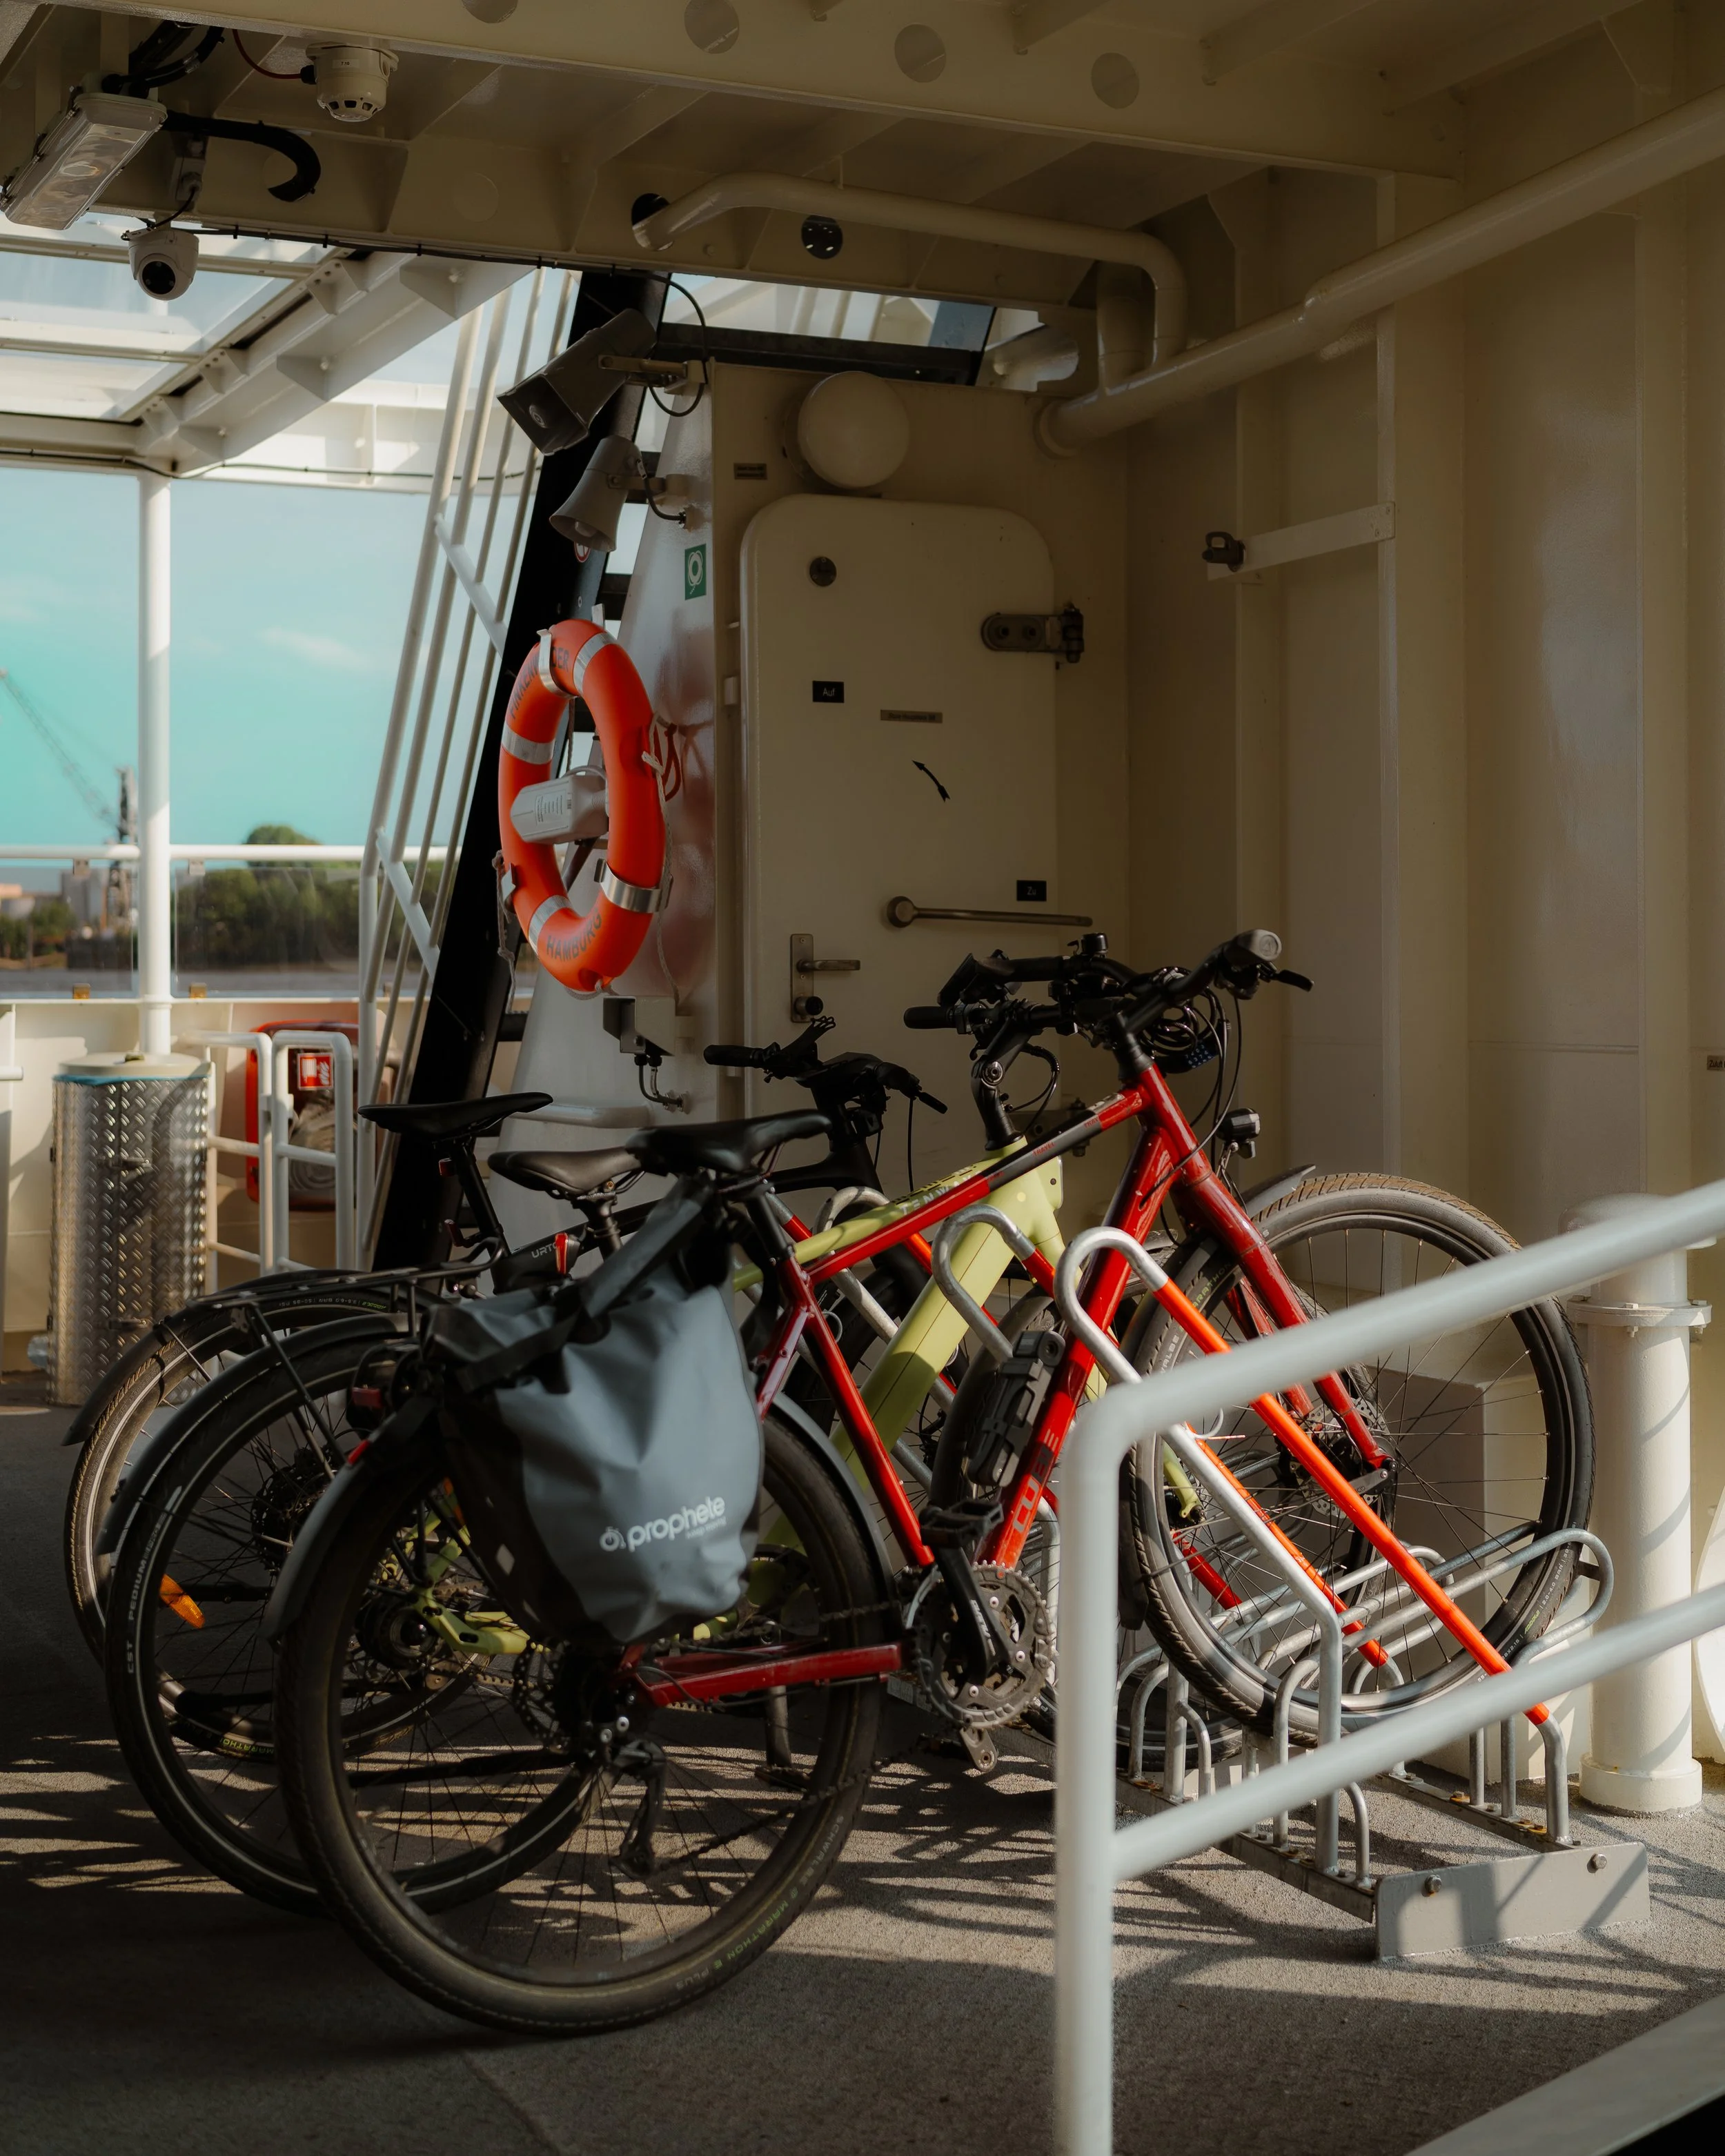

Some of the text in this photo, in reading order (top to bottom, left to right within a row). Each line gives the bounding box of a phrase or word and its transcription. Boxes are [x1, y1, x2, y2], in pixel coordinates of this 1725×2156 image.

[822, 686, 836, 697] Auf
[1027, 885, 1037, 896] Zu
[546, 909, 602, 962] HAMBURG
[1012, 1427, 1059, 1534] CUBE
[627, 1495, 725, 1553] prophete
[1555, 1563, 1564, 1582] BAR
[126, 1639, 135, 1674] CST
[798, 1815, 844, 1886] SCHWALBE
[727, 1900, 789, 1960] MARATHON
[676, 1967, 709, 1991] PLUS
